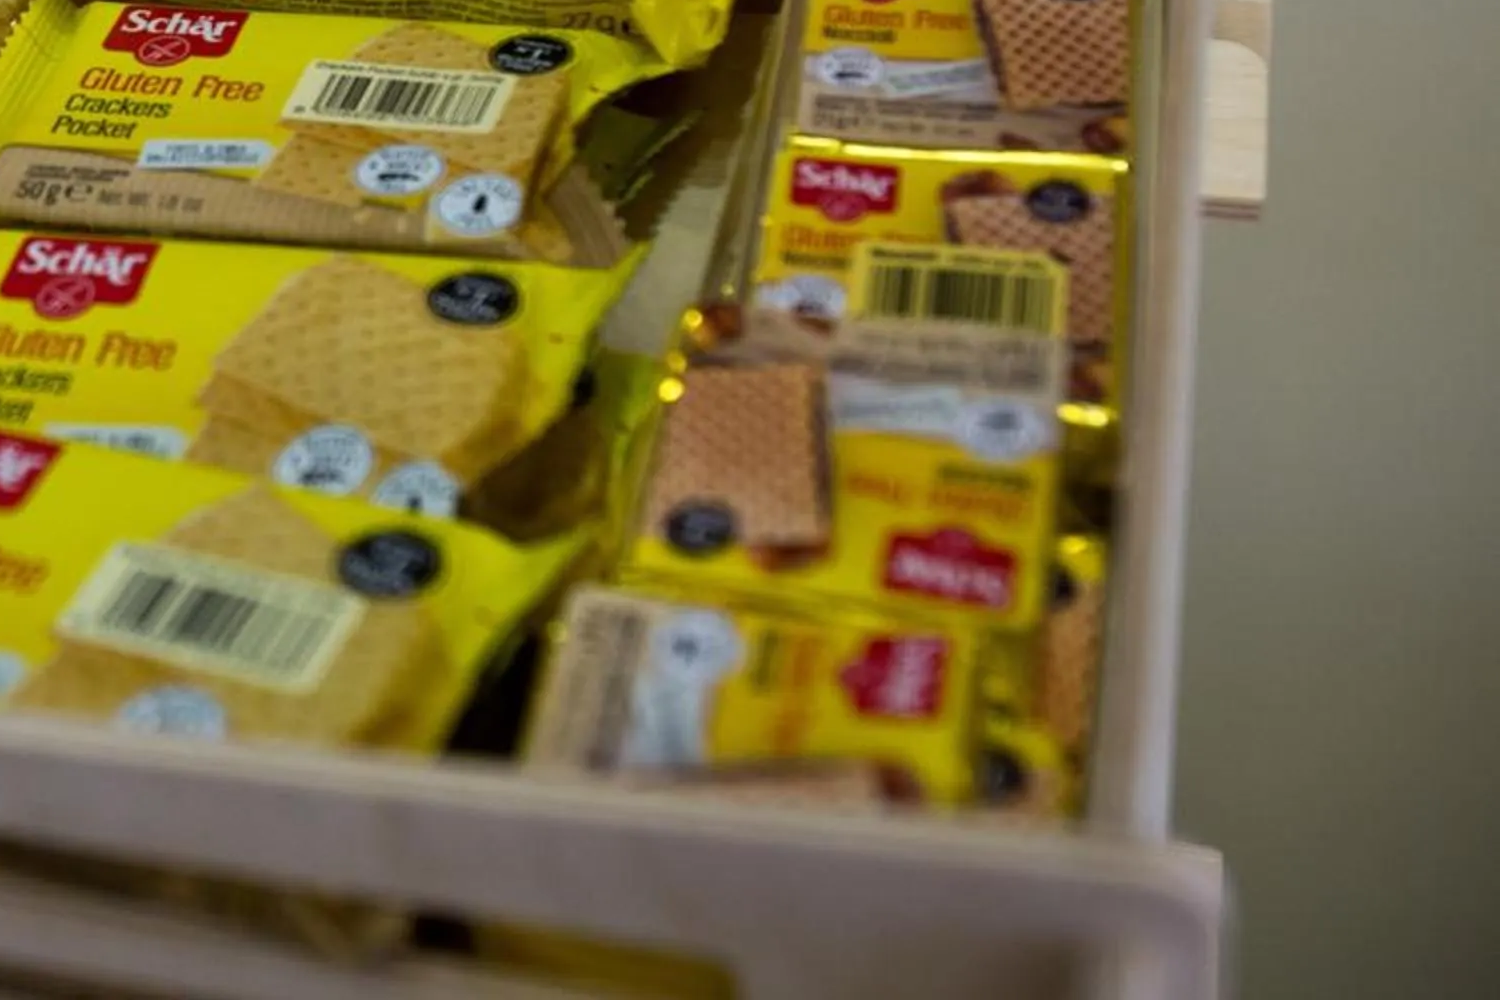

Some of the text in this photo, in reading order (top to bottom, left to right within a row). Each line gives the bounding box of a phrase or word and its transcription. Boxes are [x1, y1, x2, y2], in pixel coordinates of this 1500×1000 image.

[120, 9, 237, 43] Schär
[80, 66, 265, 102] Gluten Free
[65, 93, 173, 119] Crackers
[51, 115, 137, 139] Pocket
[16, 240, 148, 286] Schär
[94, 330, 178, 371] Free
